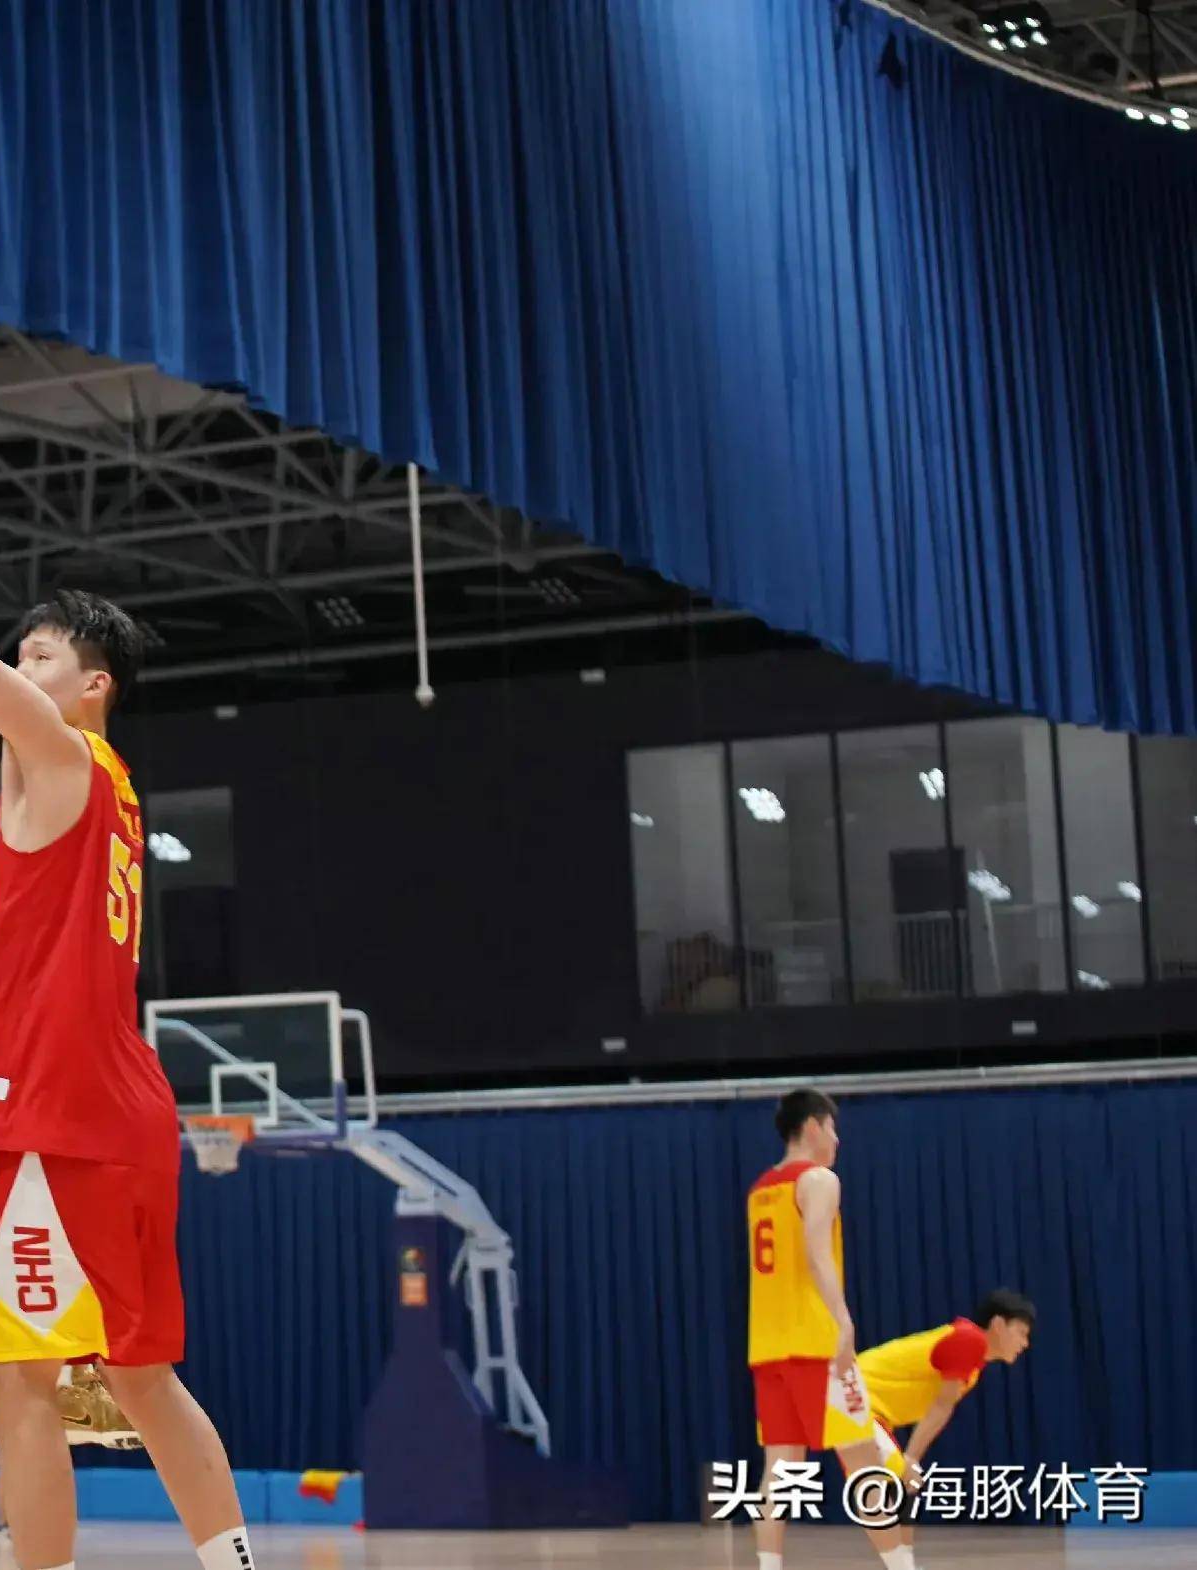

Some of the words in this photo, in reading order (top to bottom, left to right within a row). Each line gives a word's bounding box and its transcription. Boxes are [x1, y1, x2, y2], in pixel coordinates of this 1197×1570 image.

[107, 832, 143, 964] 51
[13, 1226, 57, 1313] CHN
[754, 1217, 775, 1275] 6
